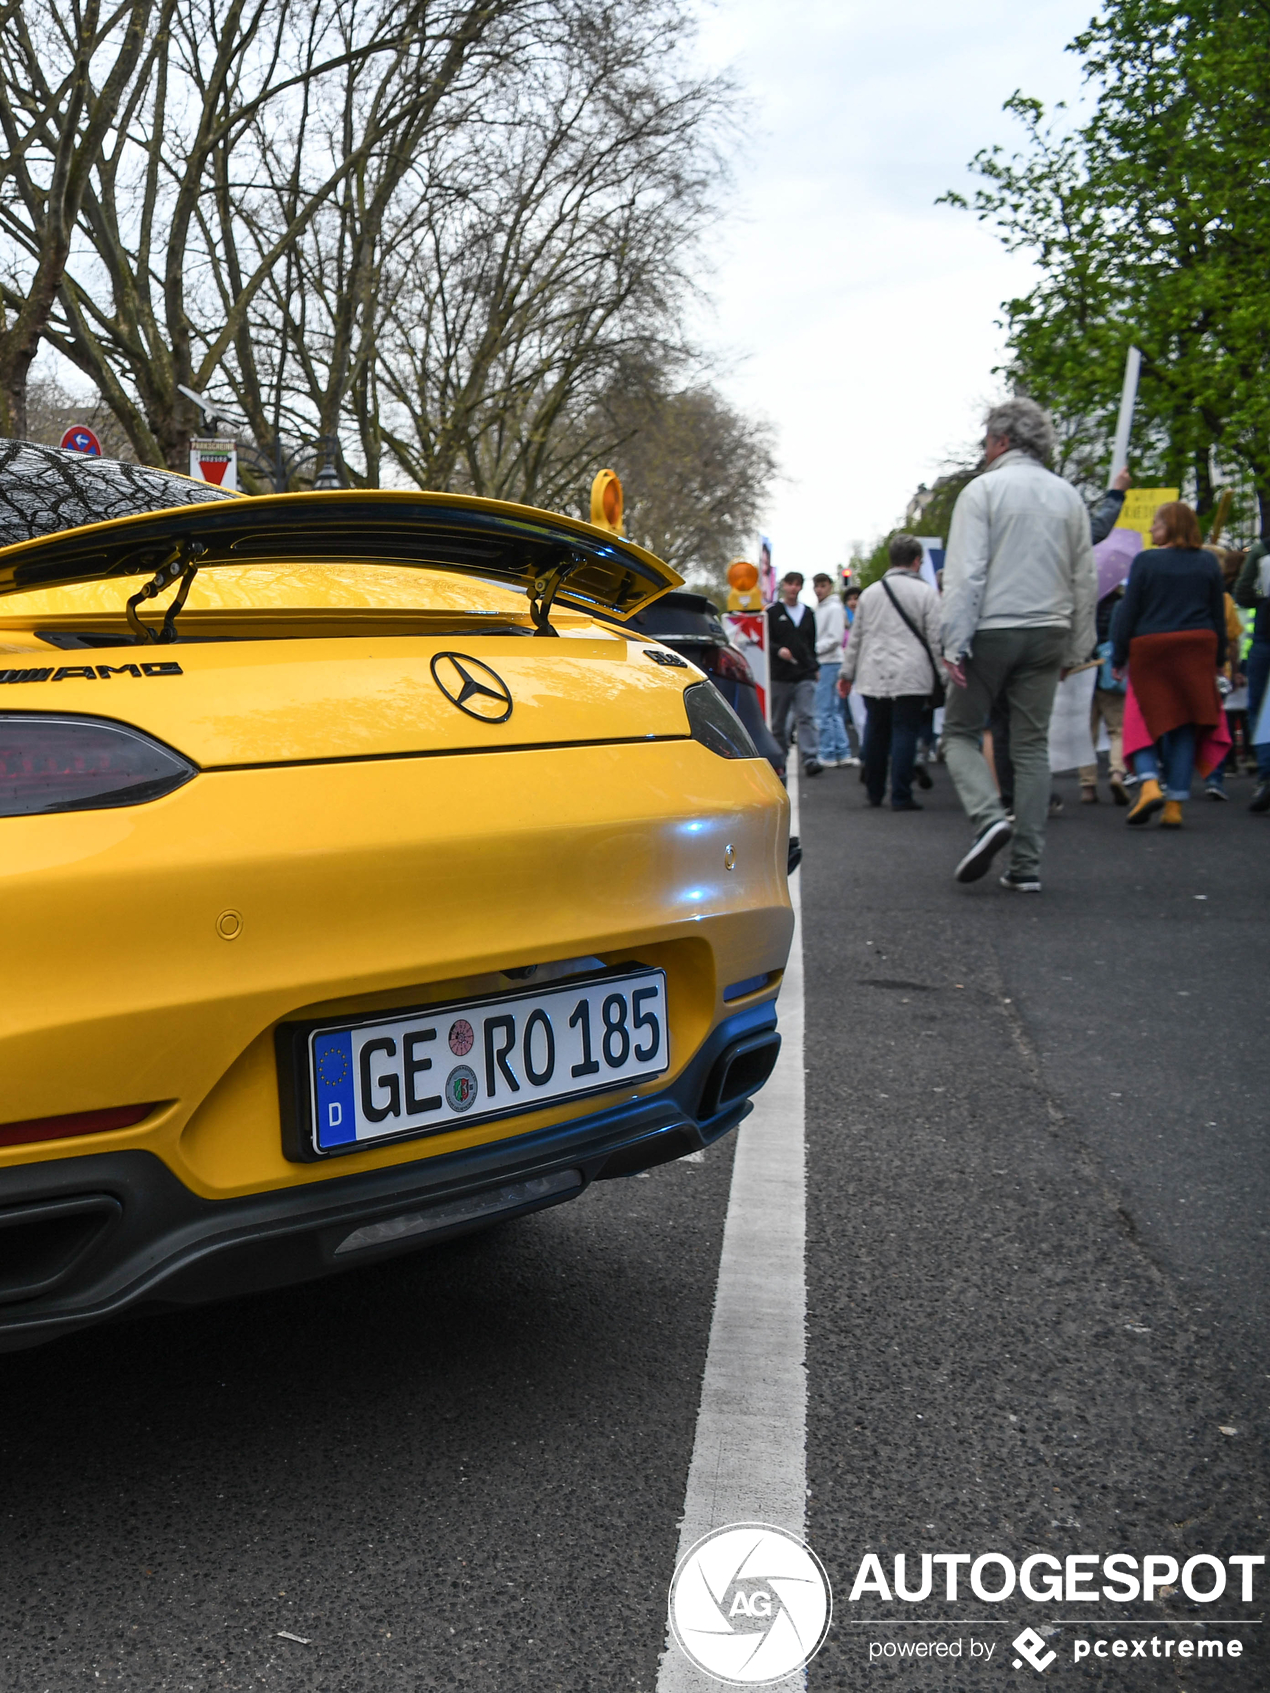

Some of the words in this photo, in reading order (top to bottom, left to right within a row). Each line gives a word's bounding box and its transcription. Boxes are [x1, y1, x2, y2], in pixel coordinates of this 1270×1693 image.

[51, 661, 184, 682] AMG
[359, 1027, 443, 1123] GE
[483, 1008, 556, 1098] RO
[568, 985, 661, 1079] 185
[328, 1101, 342, 1127] D
